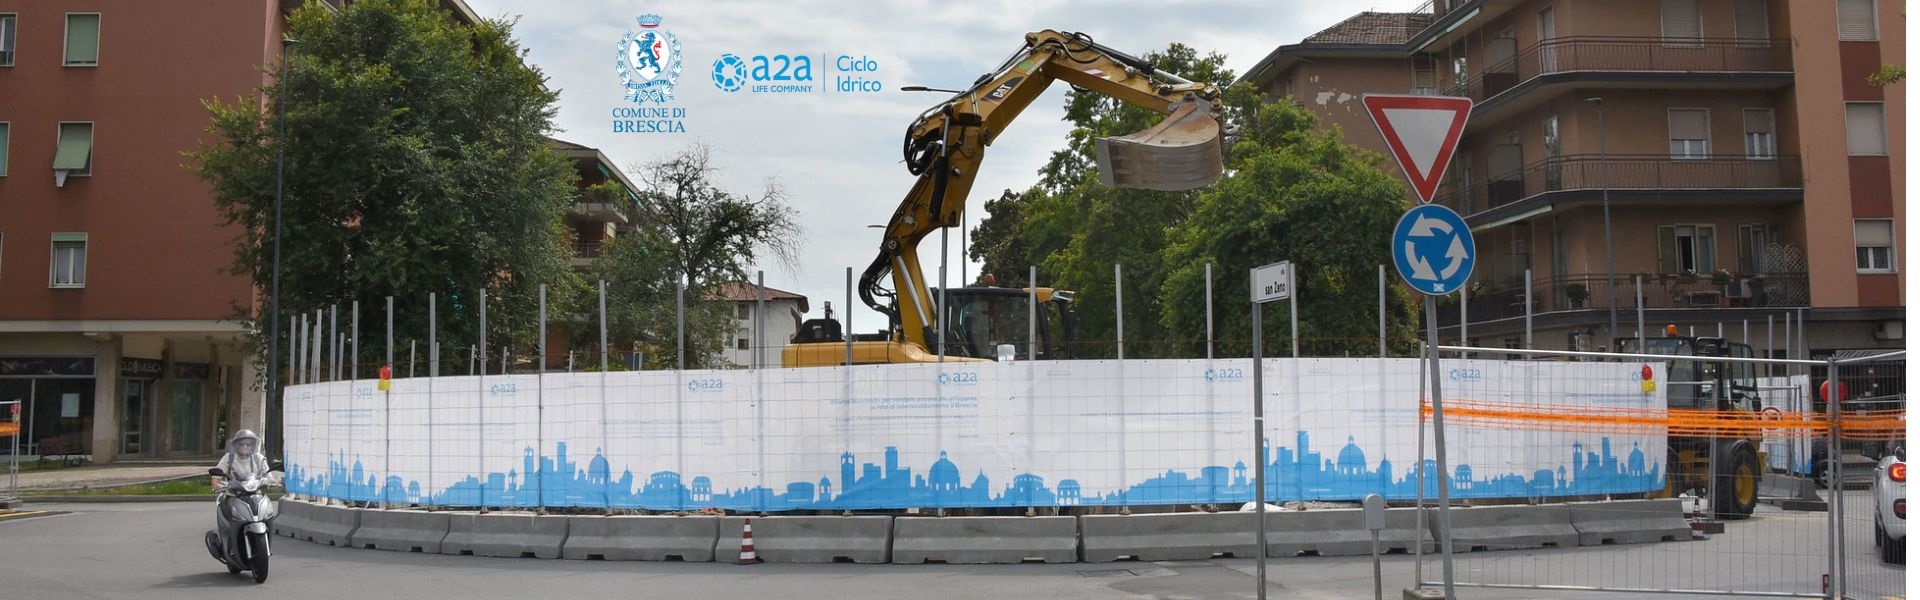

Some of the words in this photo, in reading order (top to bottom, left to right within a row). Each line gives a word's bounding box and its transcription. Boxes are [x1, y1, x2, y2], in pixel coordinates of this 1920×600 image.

[992, 83, 1012, 98] CAT
[1265, 285, 1273, 296] san
[1274, 281, 1285, 294] Zeno
[953, 372, 977, 382] a2a
[1219, 368, 1242, 378] a2a
[1462, 369, 1480, 378] a2a
[702, 379, 722, 389] a2a
